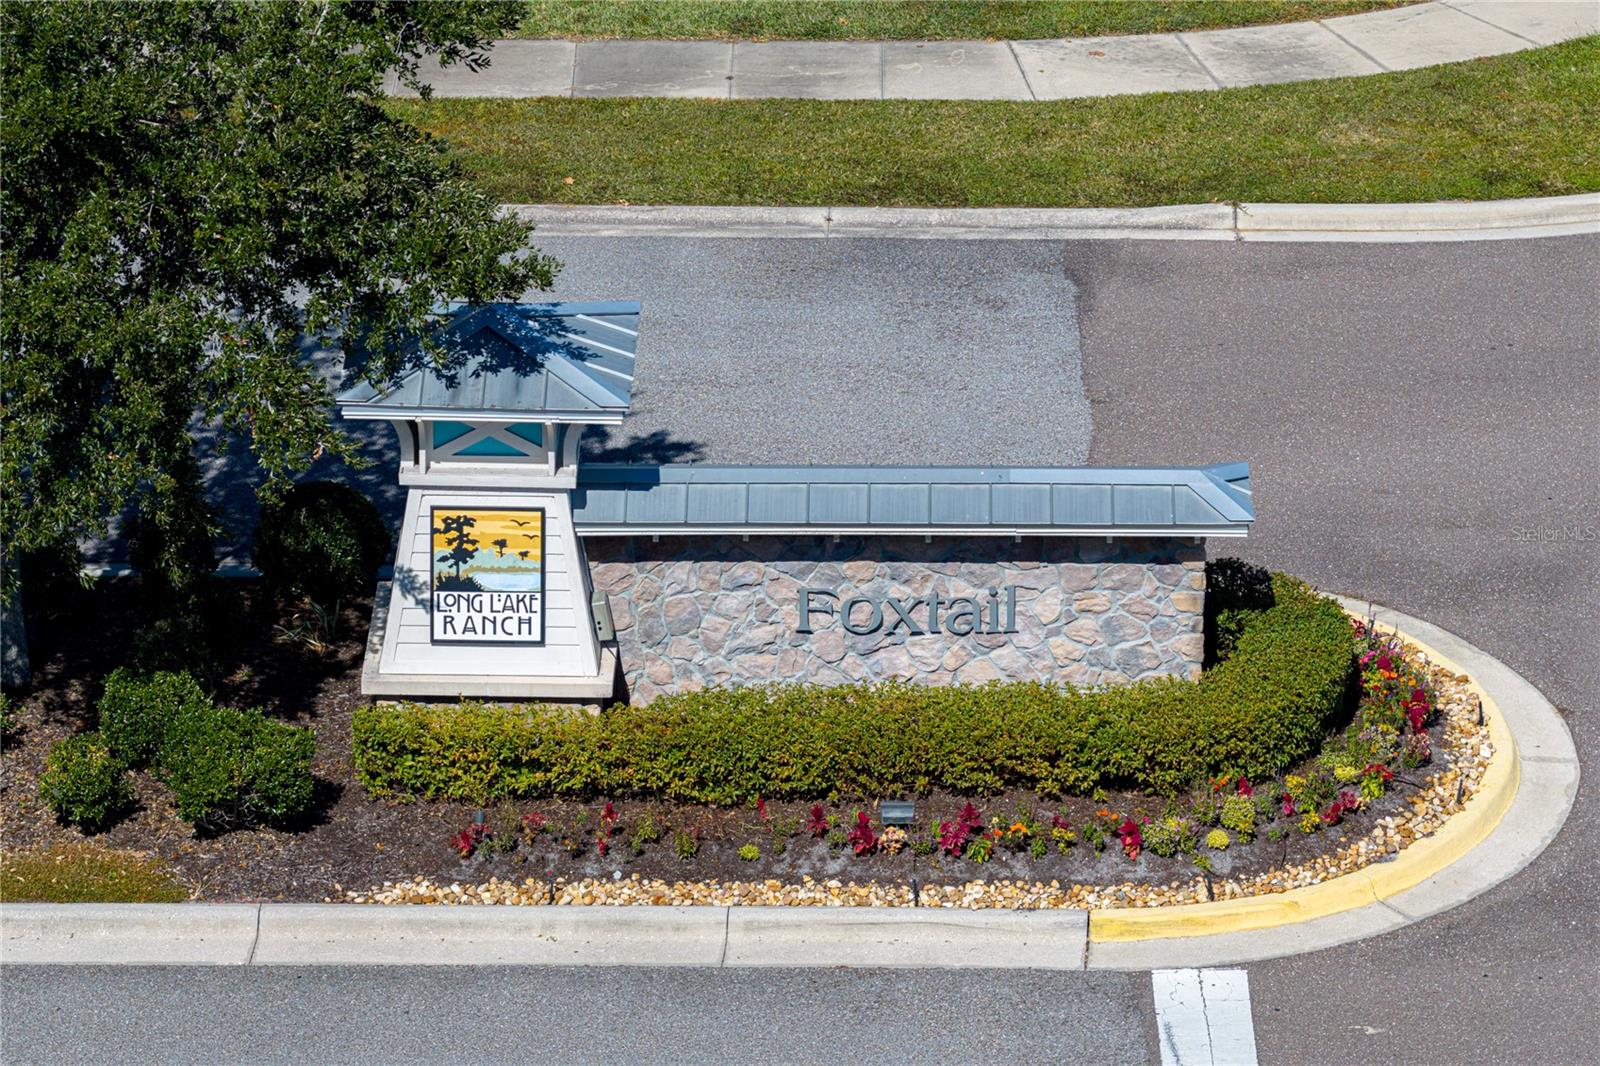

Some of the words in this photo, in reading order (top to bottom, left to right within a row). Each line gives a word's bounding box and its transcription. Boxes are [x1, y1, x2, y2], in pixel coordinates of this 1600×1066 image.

[436, 593, 483, 614] LONG
[490, 593, 538, 614] LAKE
[795, 584, 1020, 636] Foxtail
[443, 615, 532, 636] RANCH
